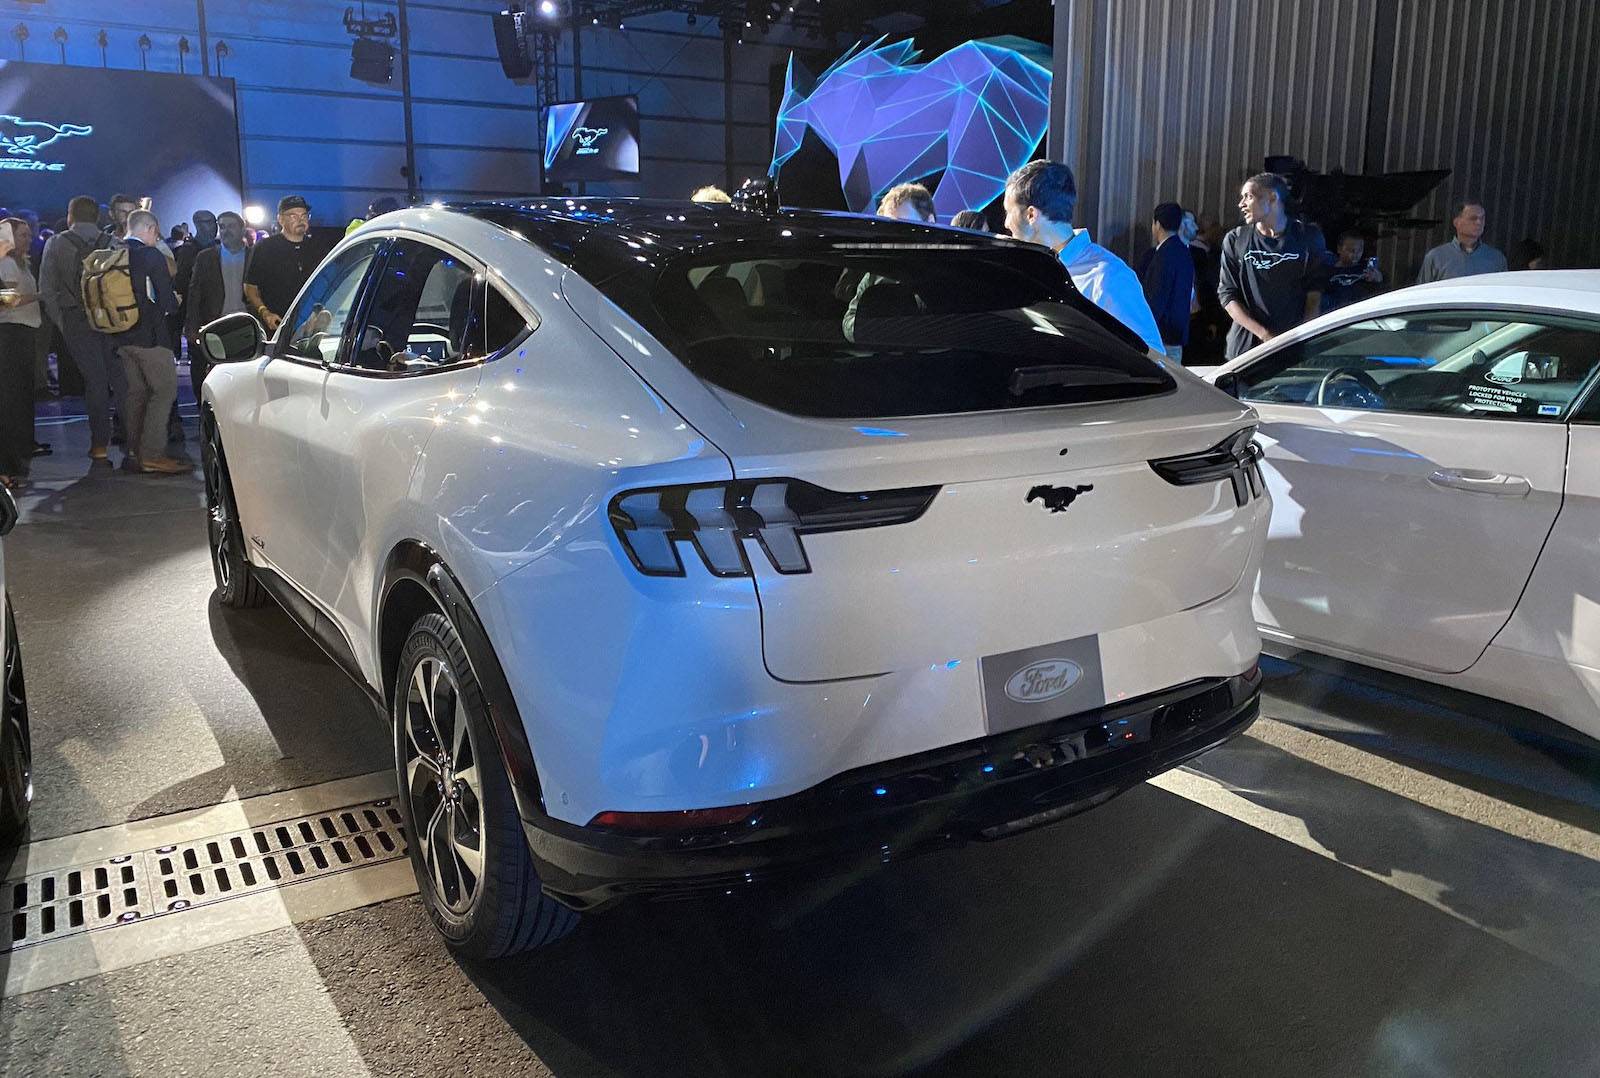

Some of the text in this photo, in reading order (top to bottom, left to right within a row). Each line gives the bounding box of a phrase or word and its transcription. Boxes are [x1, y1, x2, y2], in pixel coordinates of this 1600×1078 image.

[1468, 385, 1528, 398] PROTOTYPE VEHICLE
[1468, 390, 1493, 399] LOCKED
[1505, 396, 1523, 404] YOUR
[1473, 397, 1512, 407] PROTECTION
[1020, 664, 1069, 698] Ford
